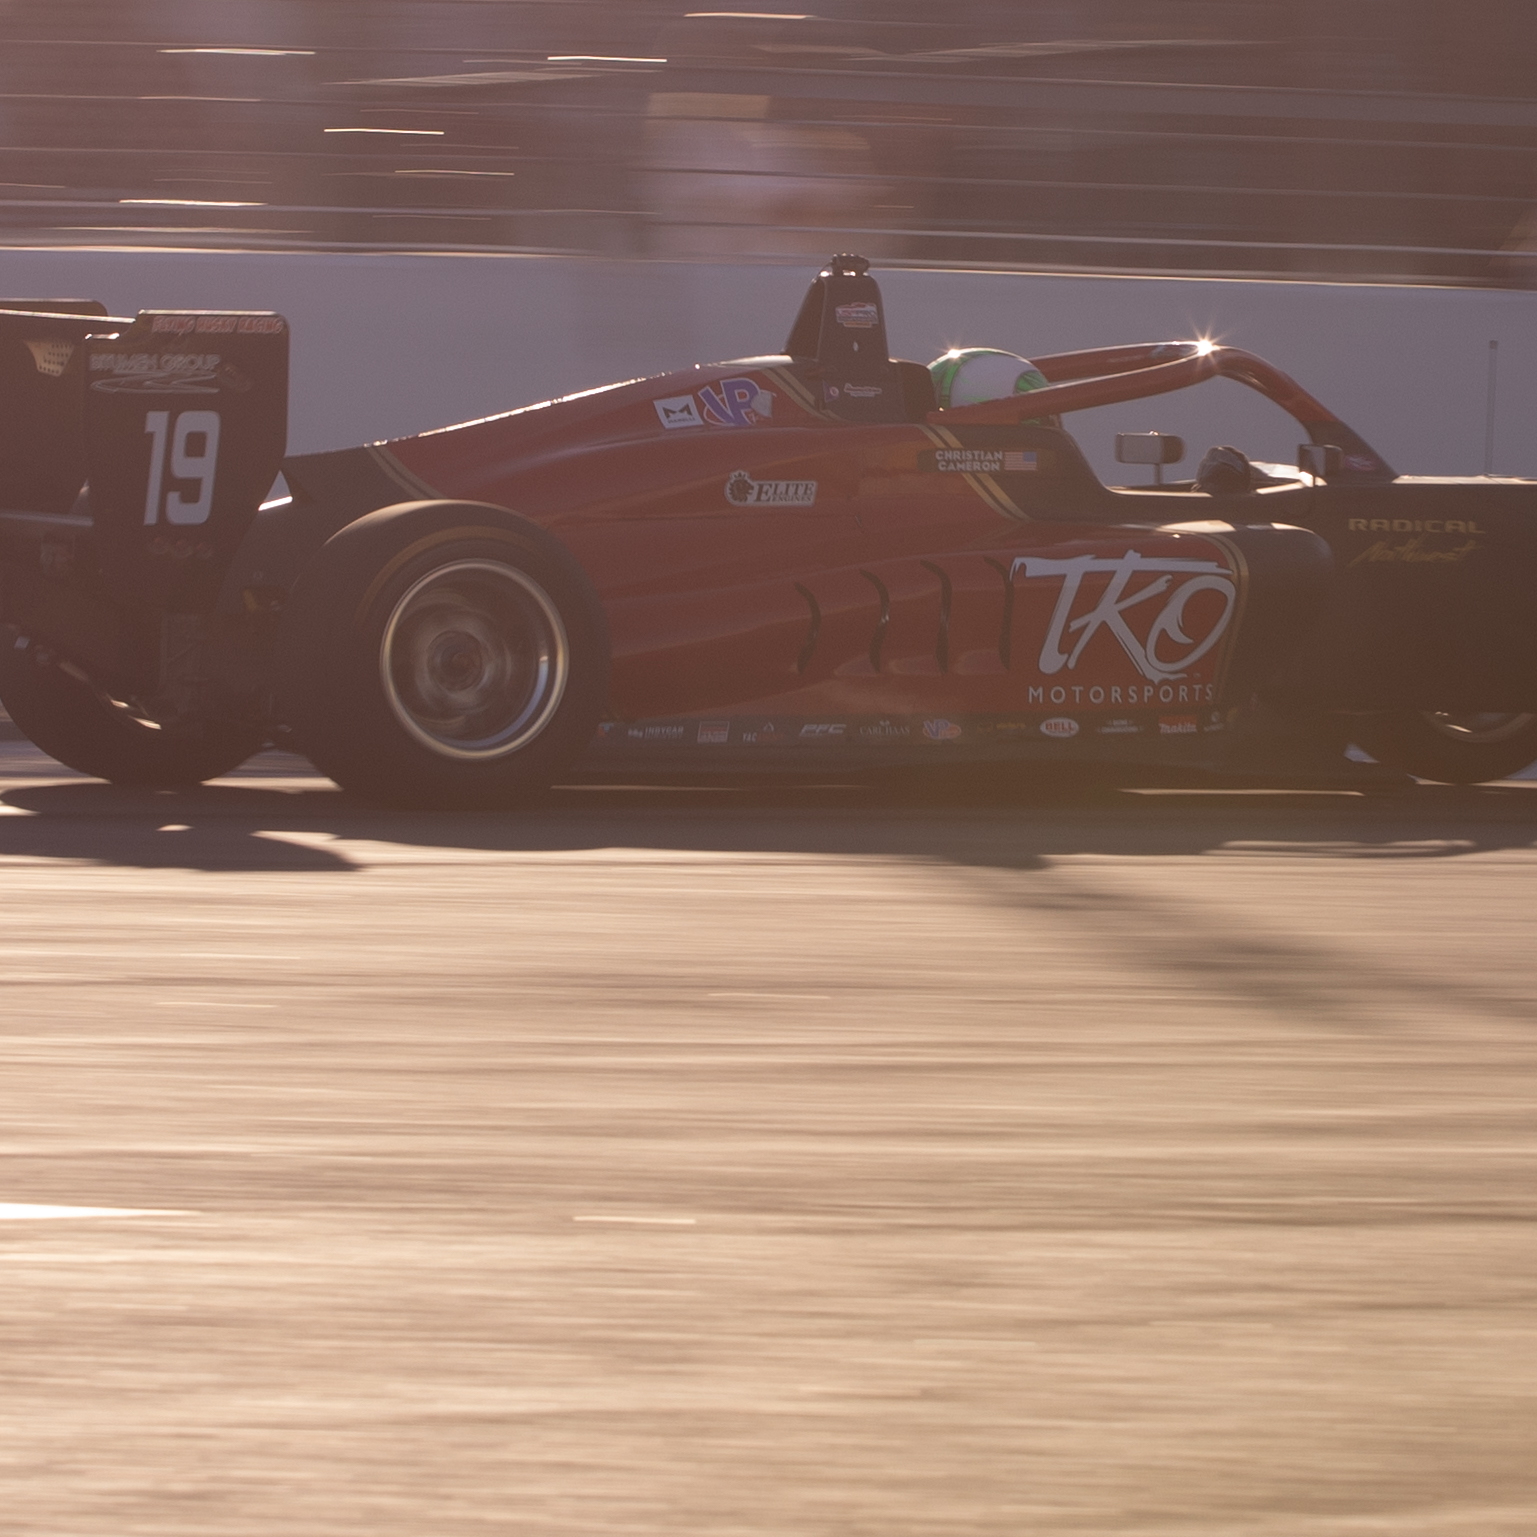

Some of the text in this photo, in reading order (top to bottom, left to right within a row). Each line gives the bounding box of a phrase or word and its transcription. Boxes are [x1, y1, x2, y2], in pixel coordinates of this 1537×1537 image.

[160, 353, 221, 372] GROUP
[698, 377, 761, 427] VP
[935, 450, 1003, 460] CHRISTIAN
[143, 410, 222, 526] 19
[938, 461, 1001, 472] CAMERON
[754, 482, 815, 503] ELITE
[1348, 518, 1486, 534] RADICAL
[1009, 549, 1237, 685] TKO
[1027, 684, 1215, 705] MOTORSPORTS
[800, 723, 847, 736] PFC
[1045, 721, 1075, 732] BELL
